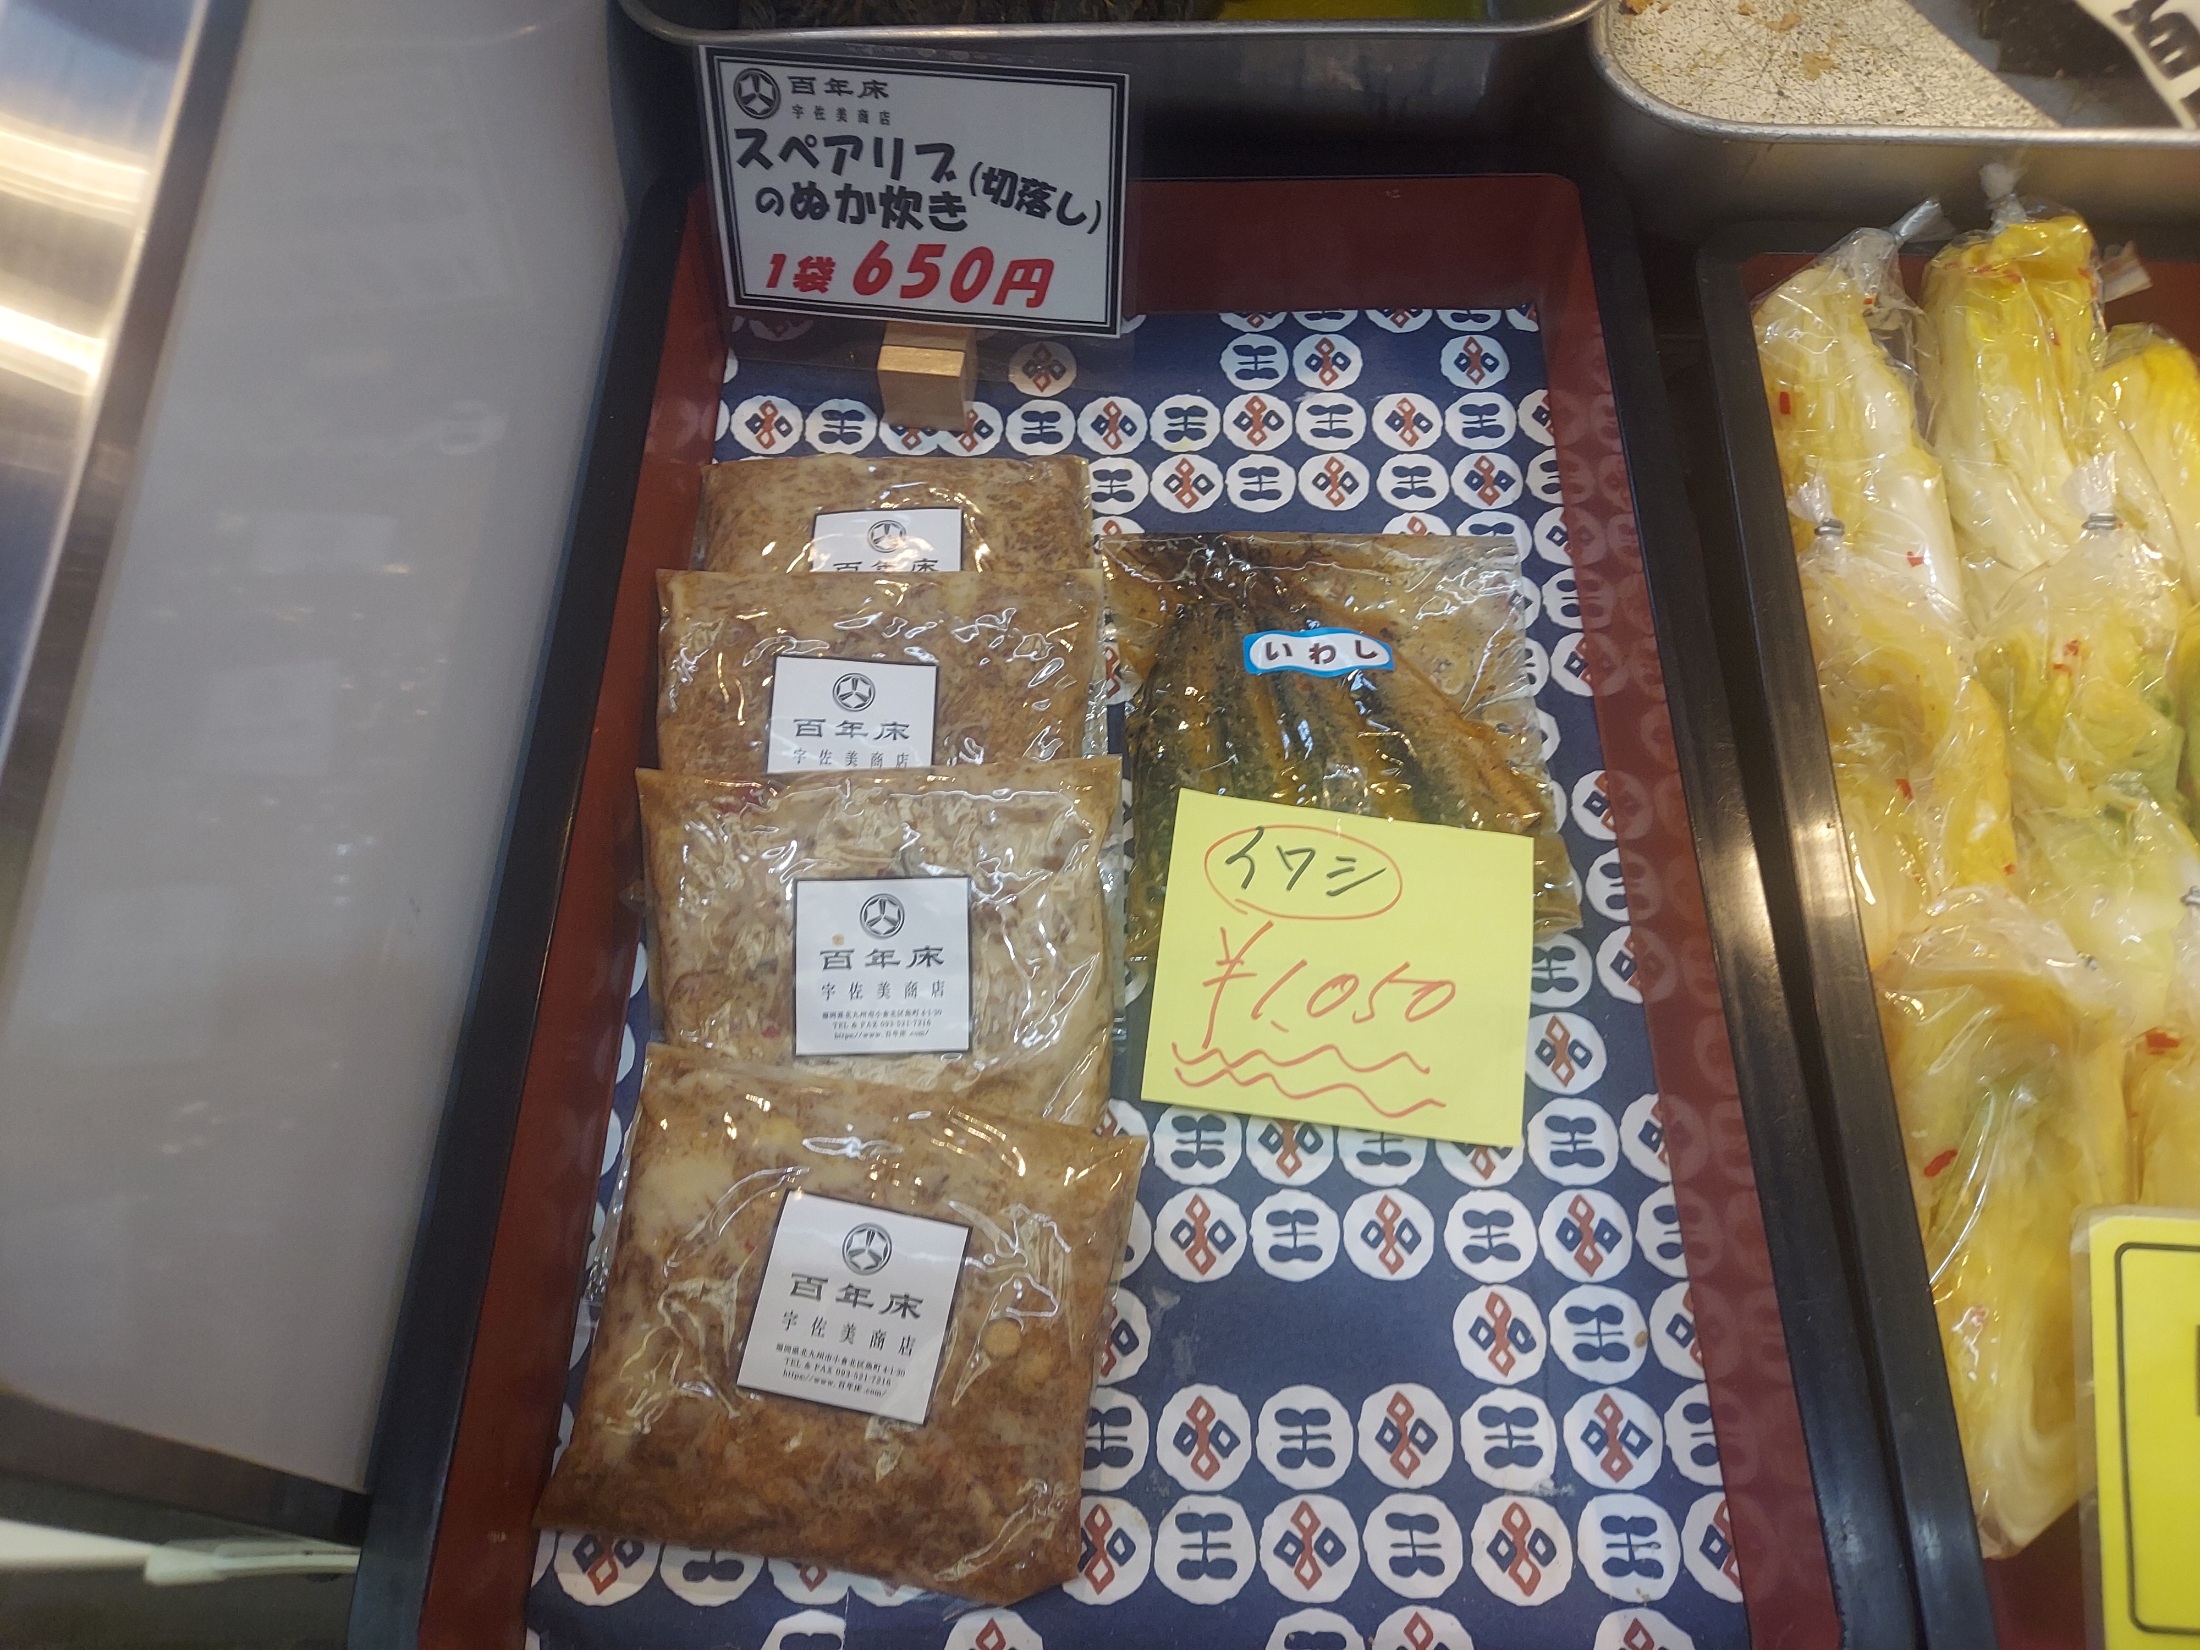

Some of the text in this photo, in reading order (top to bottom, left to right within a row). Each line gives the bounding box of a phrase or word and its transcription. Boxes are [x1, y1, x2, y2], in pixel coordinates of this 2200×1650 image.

[787, 75, 889, 99] 百年床
[792, 103, 891, 126] 宇佐美商店
[733, 128, 958, 183] スペアリブ
[756, 180, 968, 232] のぬか炊き
[852, 240, 1055, 309] 650円
[1265, 639, 1378, 665] いわし
[793, 718, 910, 741] 百年床
[1225, 826, 1387, 896] イワシ
[820, 945, 944, 971] 百年床
[821, 980, 945, 1001] 宇佐美商店
[789, 1272, 924, 1320] 百年床
[781, 1309, 917, 1358] 宇佐美商店
